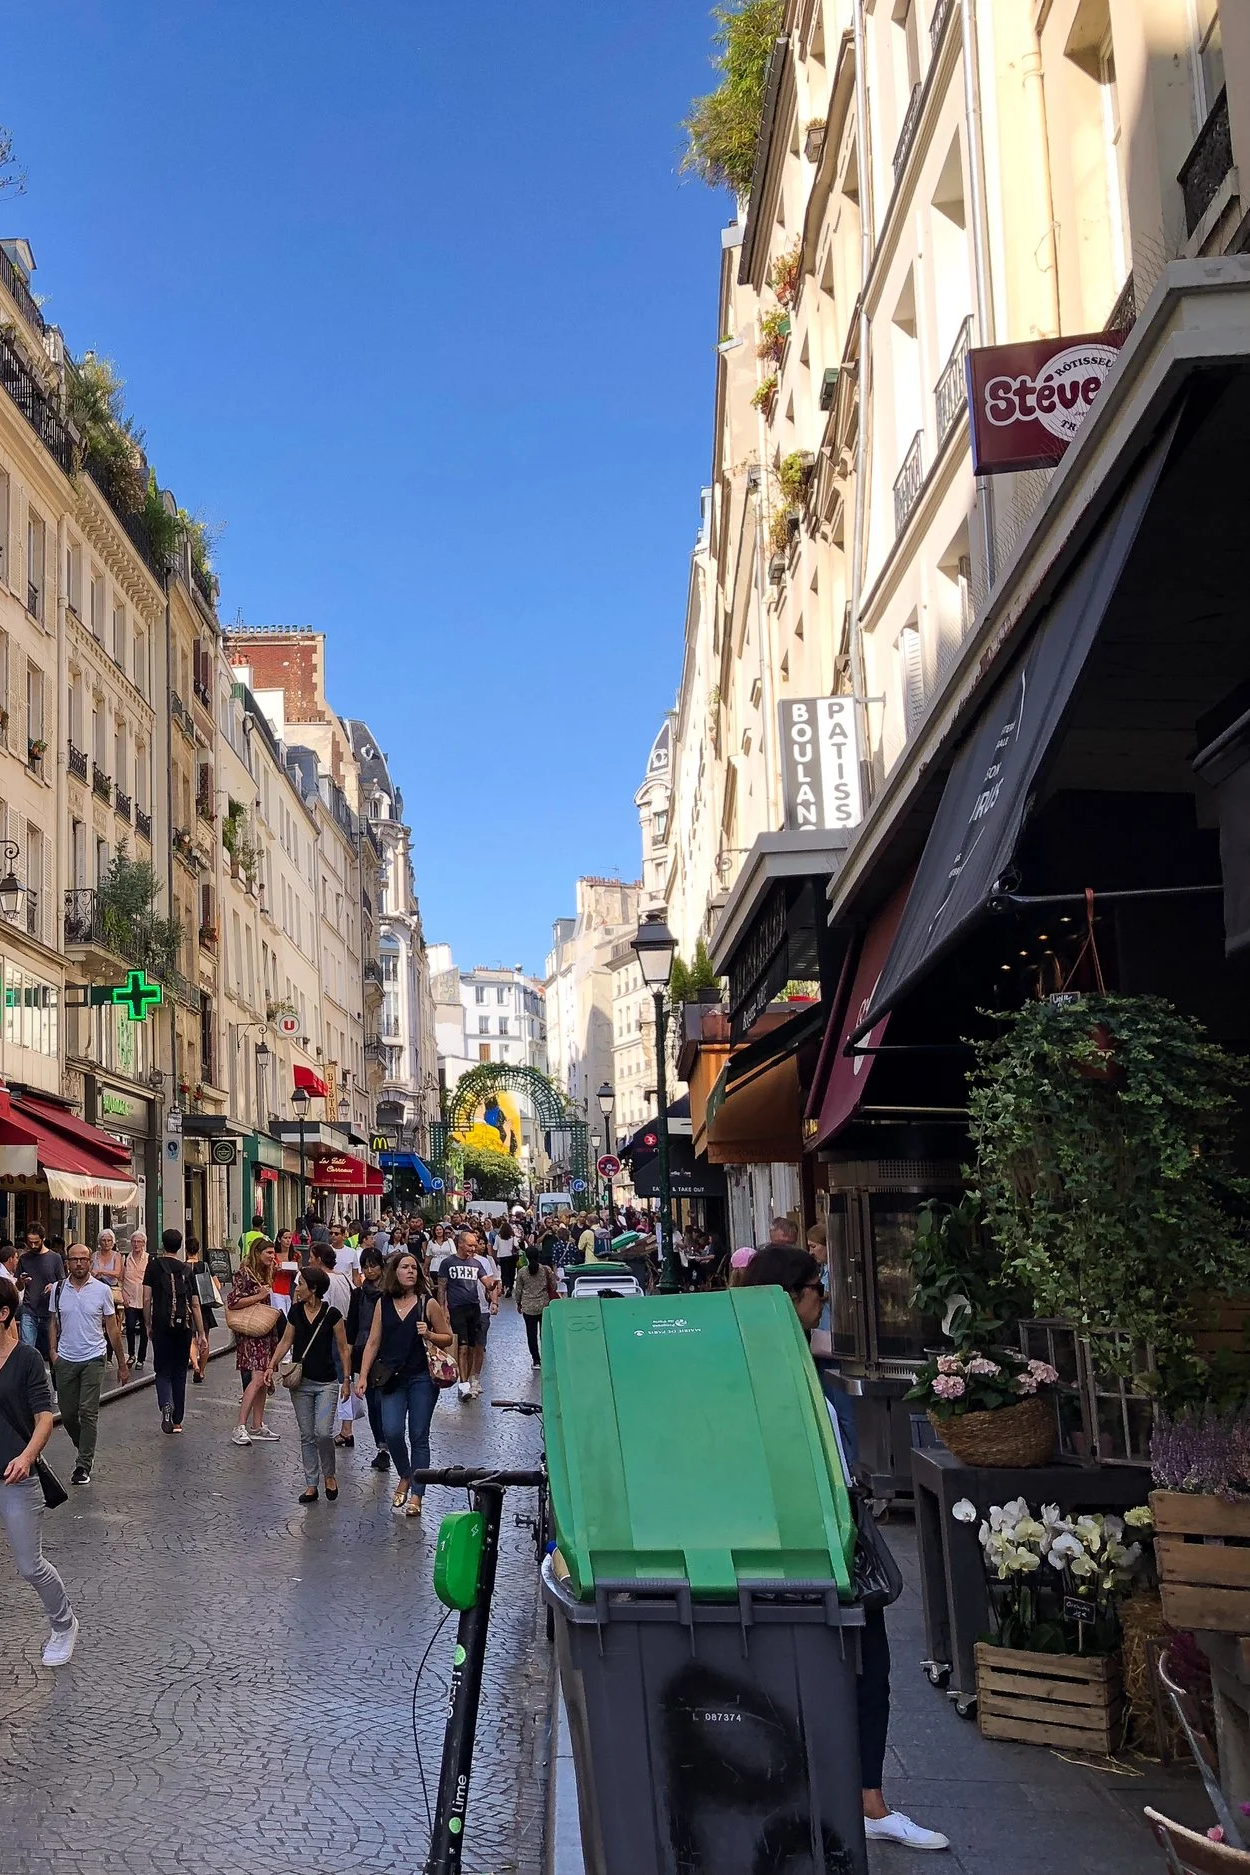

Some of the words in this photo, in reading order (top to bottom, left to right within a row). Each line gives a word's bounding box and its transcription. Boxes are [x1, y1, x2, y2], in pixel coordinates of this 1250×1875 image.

[828, 702, 852, 828] PATISS
[284, 1020, 294, 1030] U
[705, 1713, 742, 1722] 087374
[452, 1774, 468, 1812] Lime
